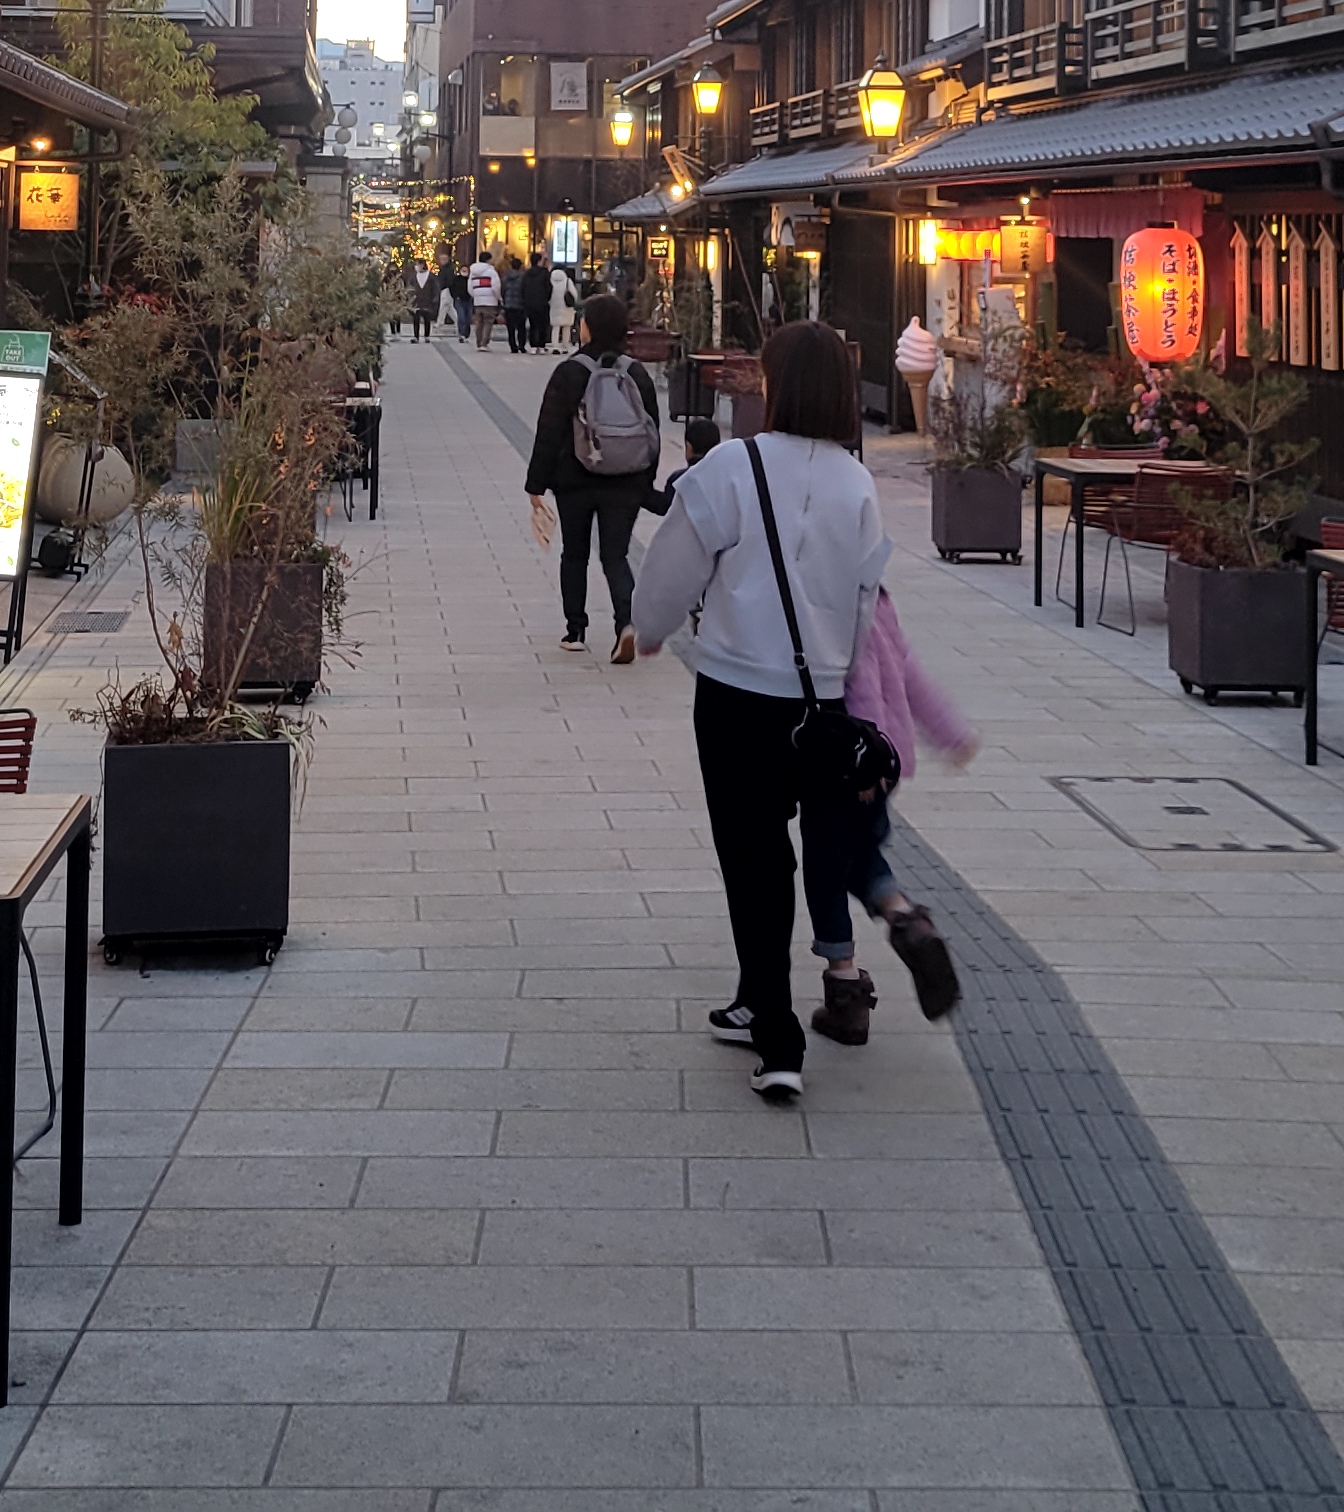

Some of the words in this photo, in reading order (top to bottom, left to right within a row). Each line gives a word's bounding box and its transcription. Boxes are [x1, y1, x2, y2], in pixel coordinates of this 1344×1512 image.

[1161, 244, 1181, 349] そば・ほうとう
